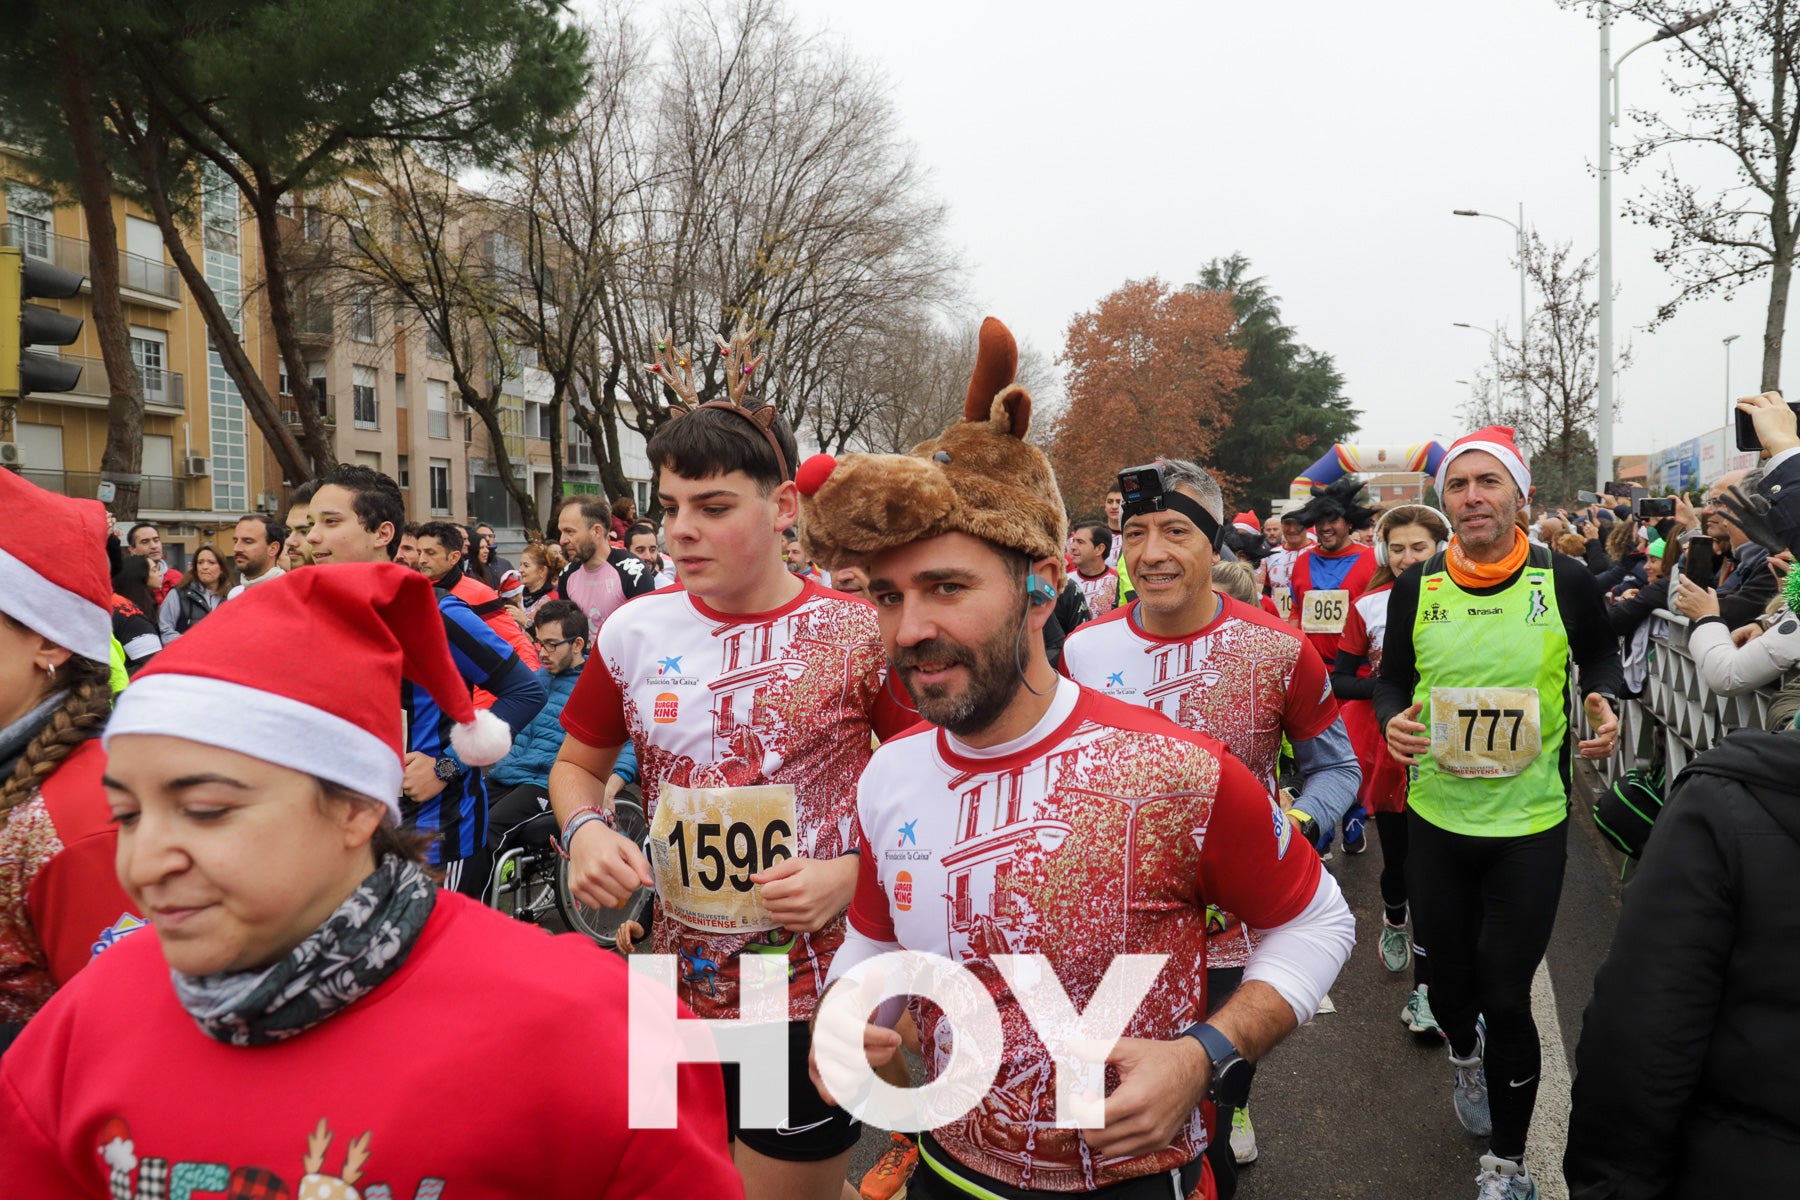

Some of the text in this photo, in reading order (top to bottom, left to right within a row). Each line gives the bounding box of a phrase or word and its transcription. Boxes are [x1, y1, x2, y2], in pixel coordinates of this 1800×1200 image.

[1314, 600, 1343, 621] 965
[646, 678, 670, 686] Fundación
[655, 701, 679, 709] BURGER
[654, 708, 678, 718] KING
[1457, 709, 1525, 752] 777
[668, 819, 793, 892] 1596
[894, 891, 912, 904] KING
[697, 912, 730, 921] SILVESTRE
